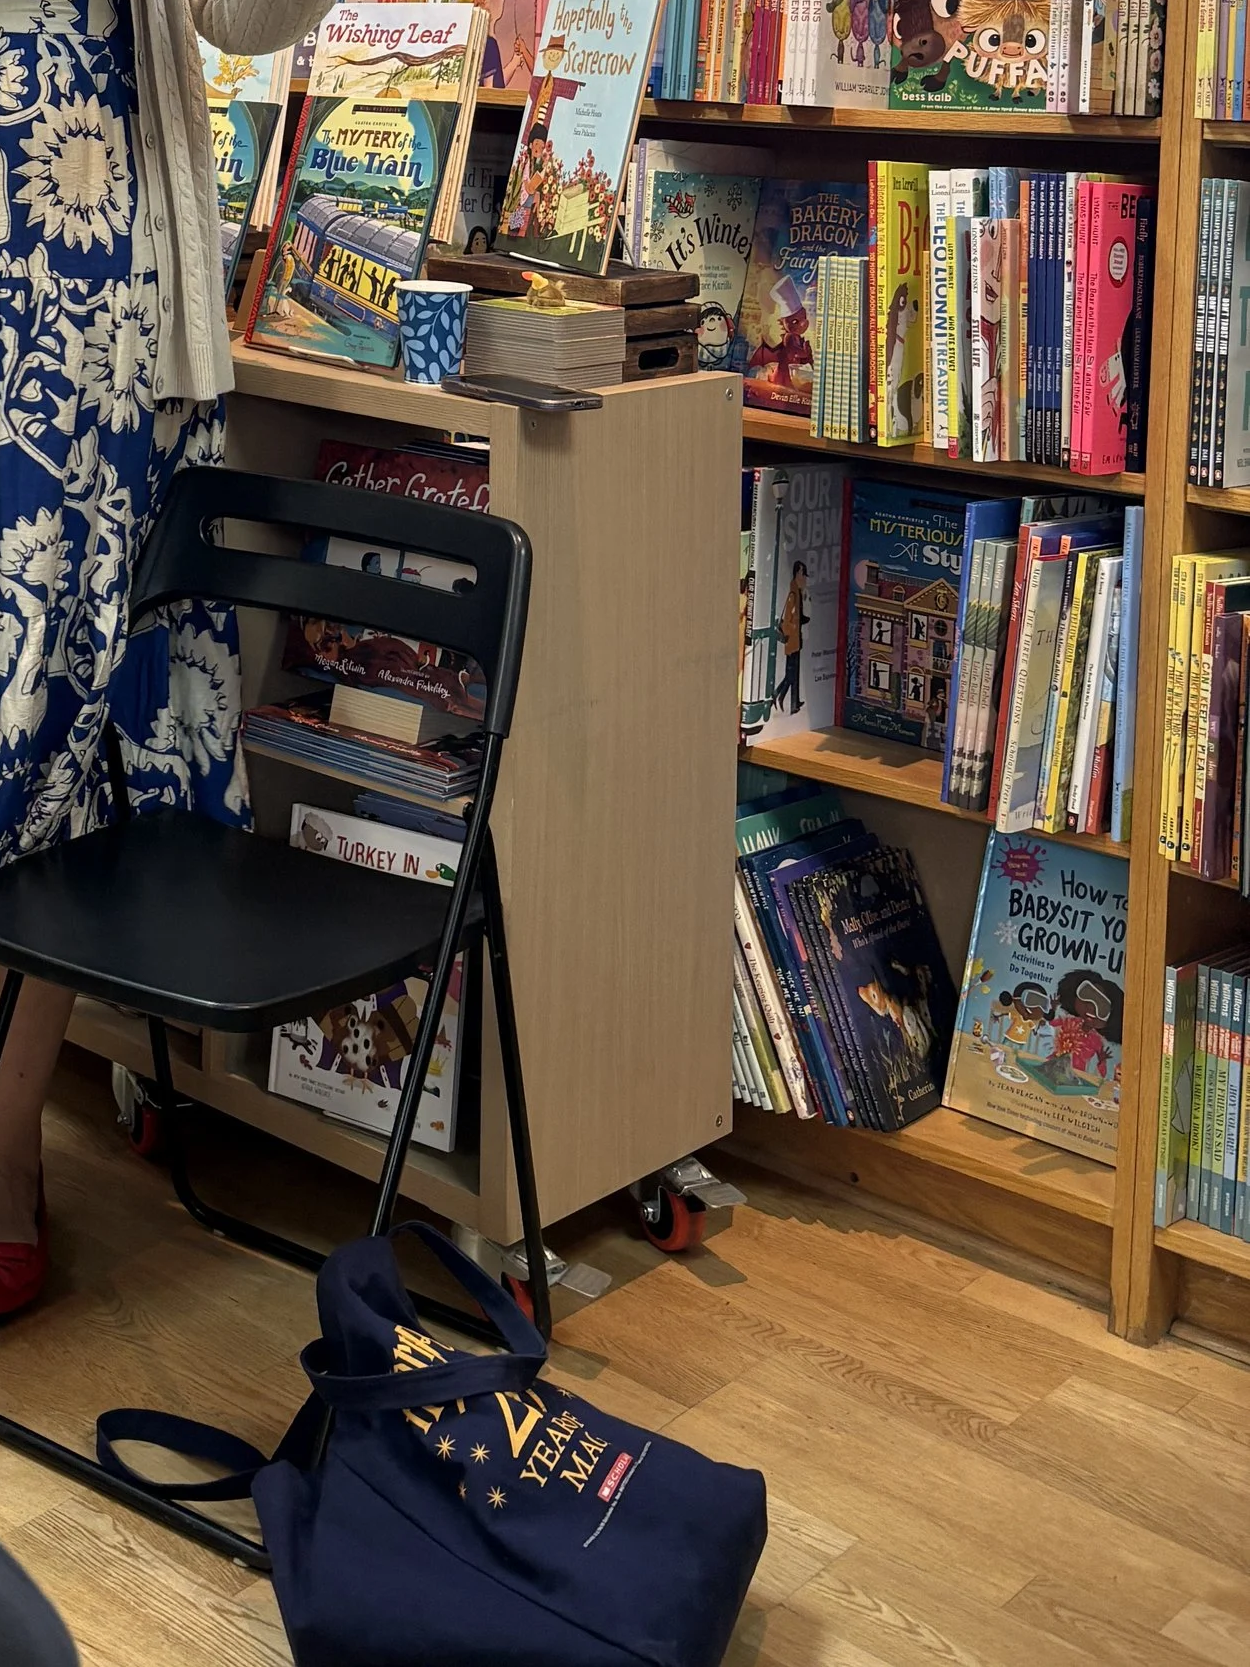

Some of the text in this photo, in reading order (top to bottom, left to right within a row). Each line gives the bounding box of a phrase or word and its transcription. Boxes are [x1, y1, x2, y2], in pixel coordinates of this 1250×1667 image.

[339, 9, 359, 21] The
[620, 3, 633, 36] the
[326, 22, 457, 50] Wishing Leaf
[564, 42, 637, 77] Scarecrow
[902, 92, 952, 102] bess kalb
[309, 147, 425, 187] Blue Train
[818, 193, 839, 204] THE
[792, 206, 864, 228] BAKERY
[790, 225, 859, 249] DRAGON
[972, 348, 980, 368] LIFE
[933, 514, 958, 530] The
[338, 835, 420, 876] TURKEY IN
[1008, 888, 1095, 934] BABYSIT
[1011, 951, 1055, 971] Activities to
[1009, 963, 1053, 984] Do Together
